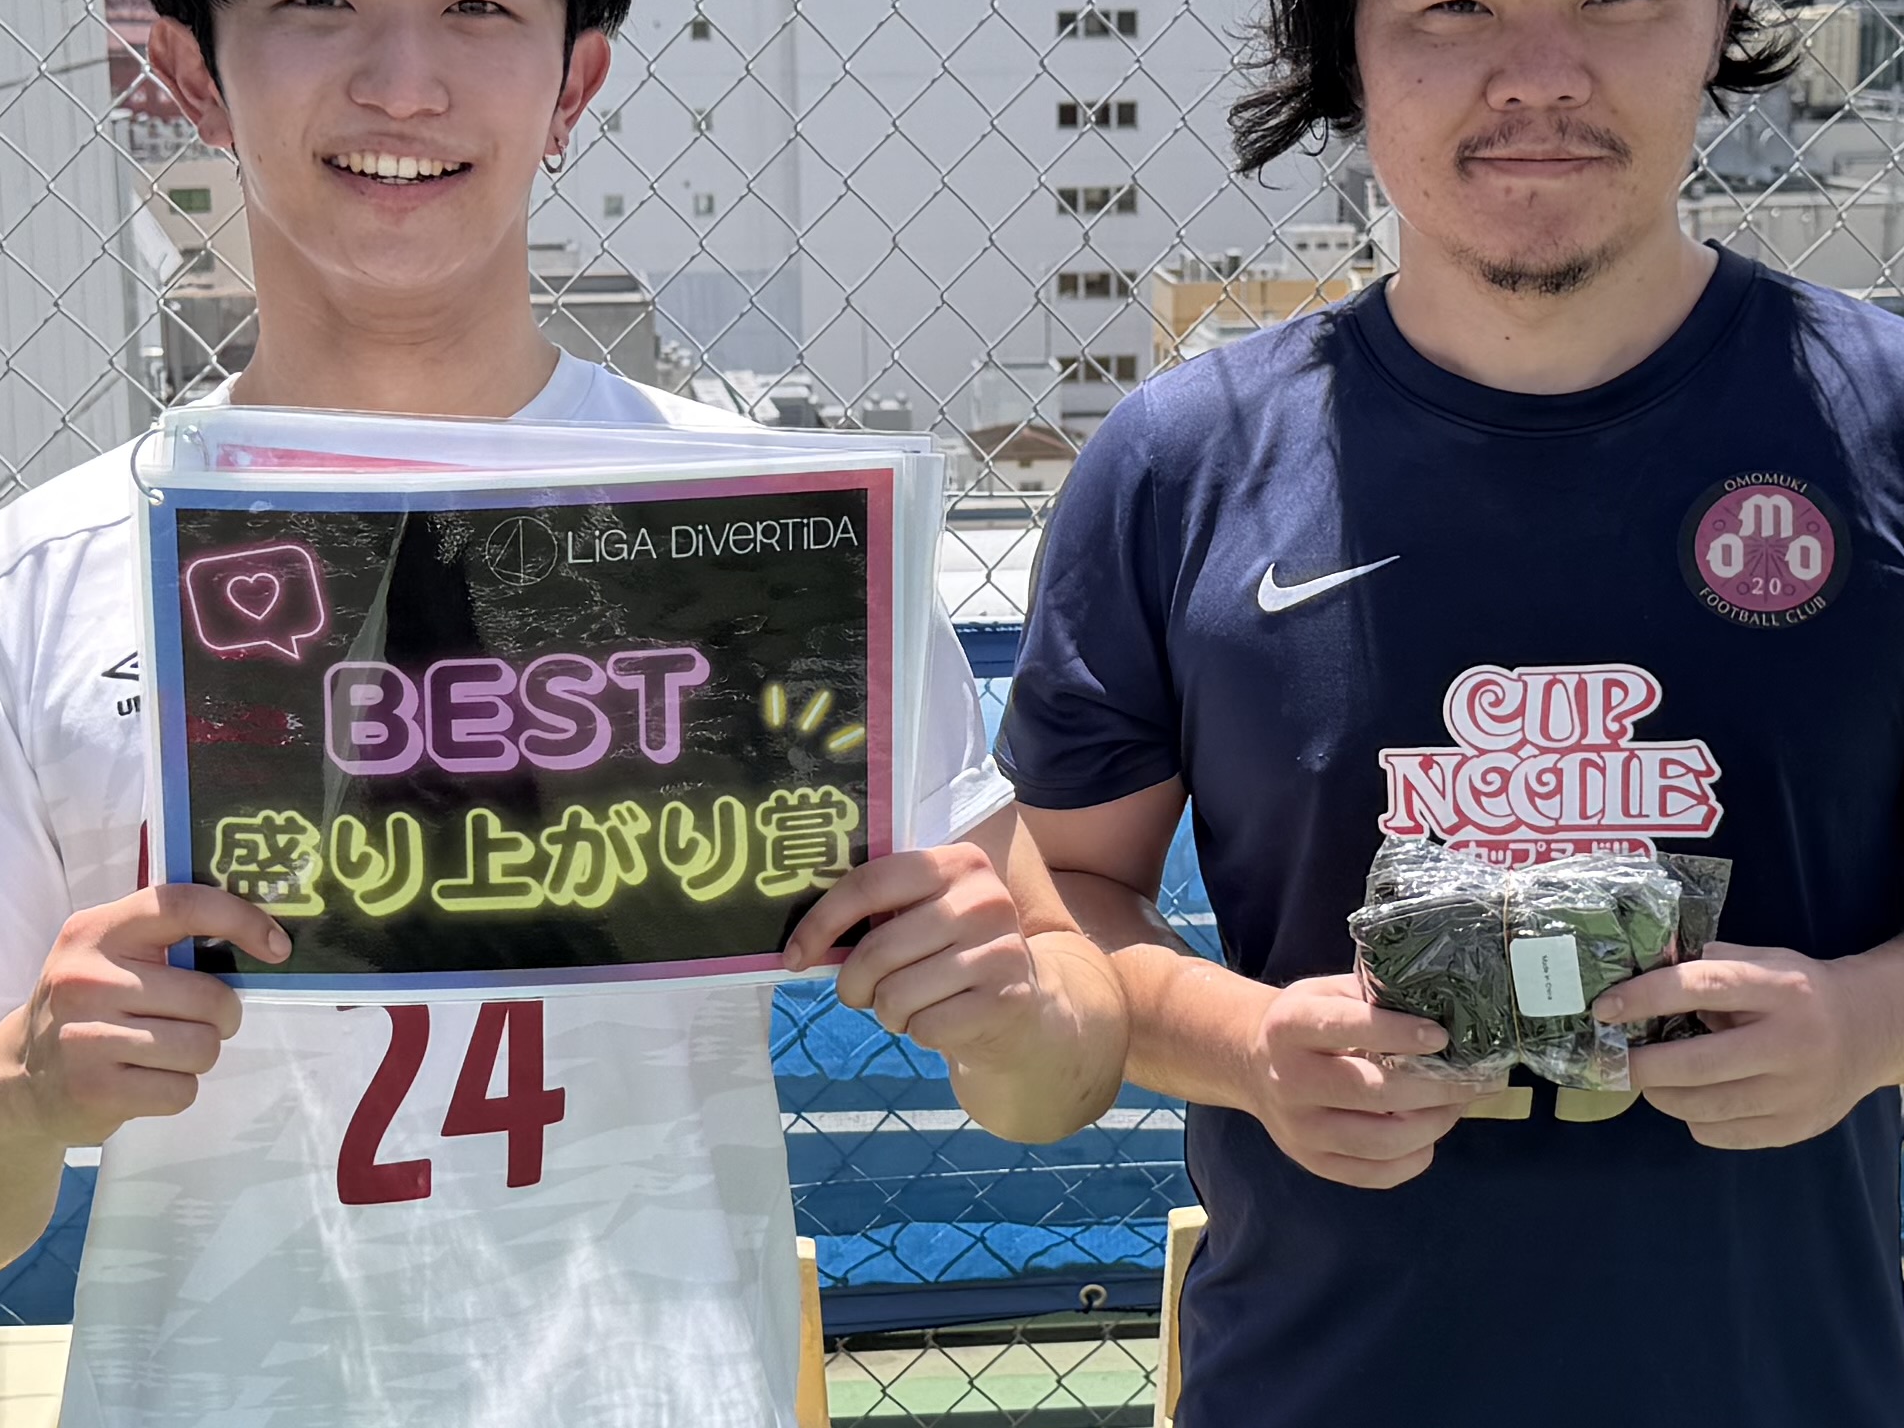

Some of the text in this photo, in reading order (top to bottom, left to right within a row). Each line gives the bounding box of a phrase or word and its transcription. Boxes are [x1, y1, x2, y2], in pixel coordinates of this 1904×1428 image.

[1724, 473, 1807, 492] OMOMUKI
[1699, 587, 1827, 627] FOOTBALL CLUB
[323, 648, 711, 776] BEST
[1445, 666, 1660, 750] CUP
[1382, 747, 1722, 835] NOODLE
[214, 784, 860, 917] 盛り上がり賞
[336, 1000, 566, 1206] 24
